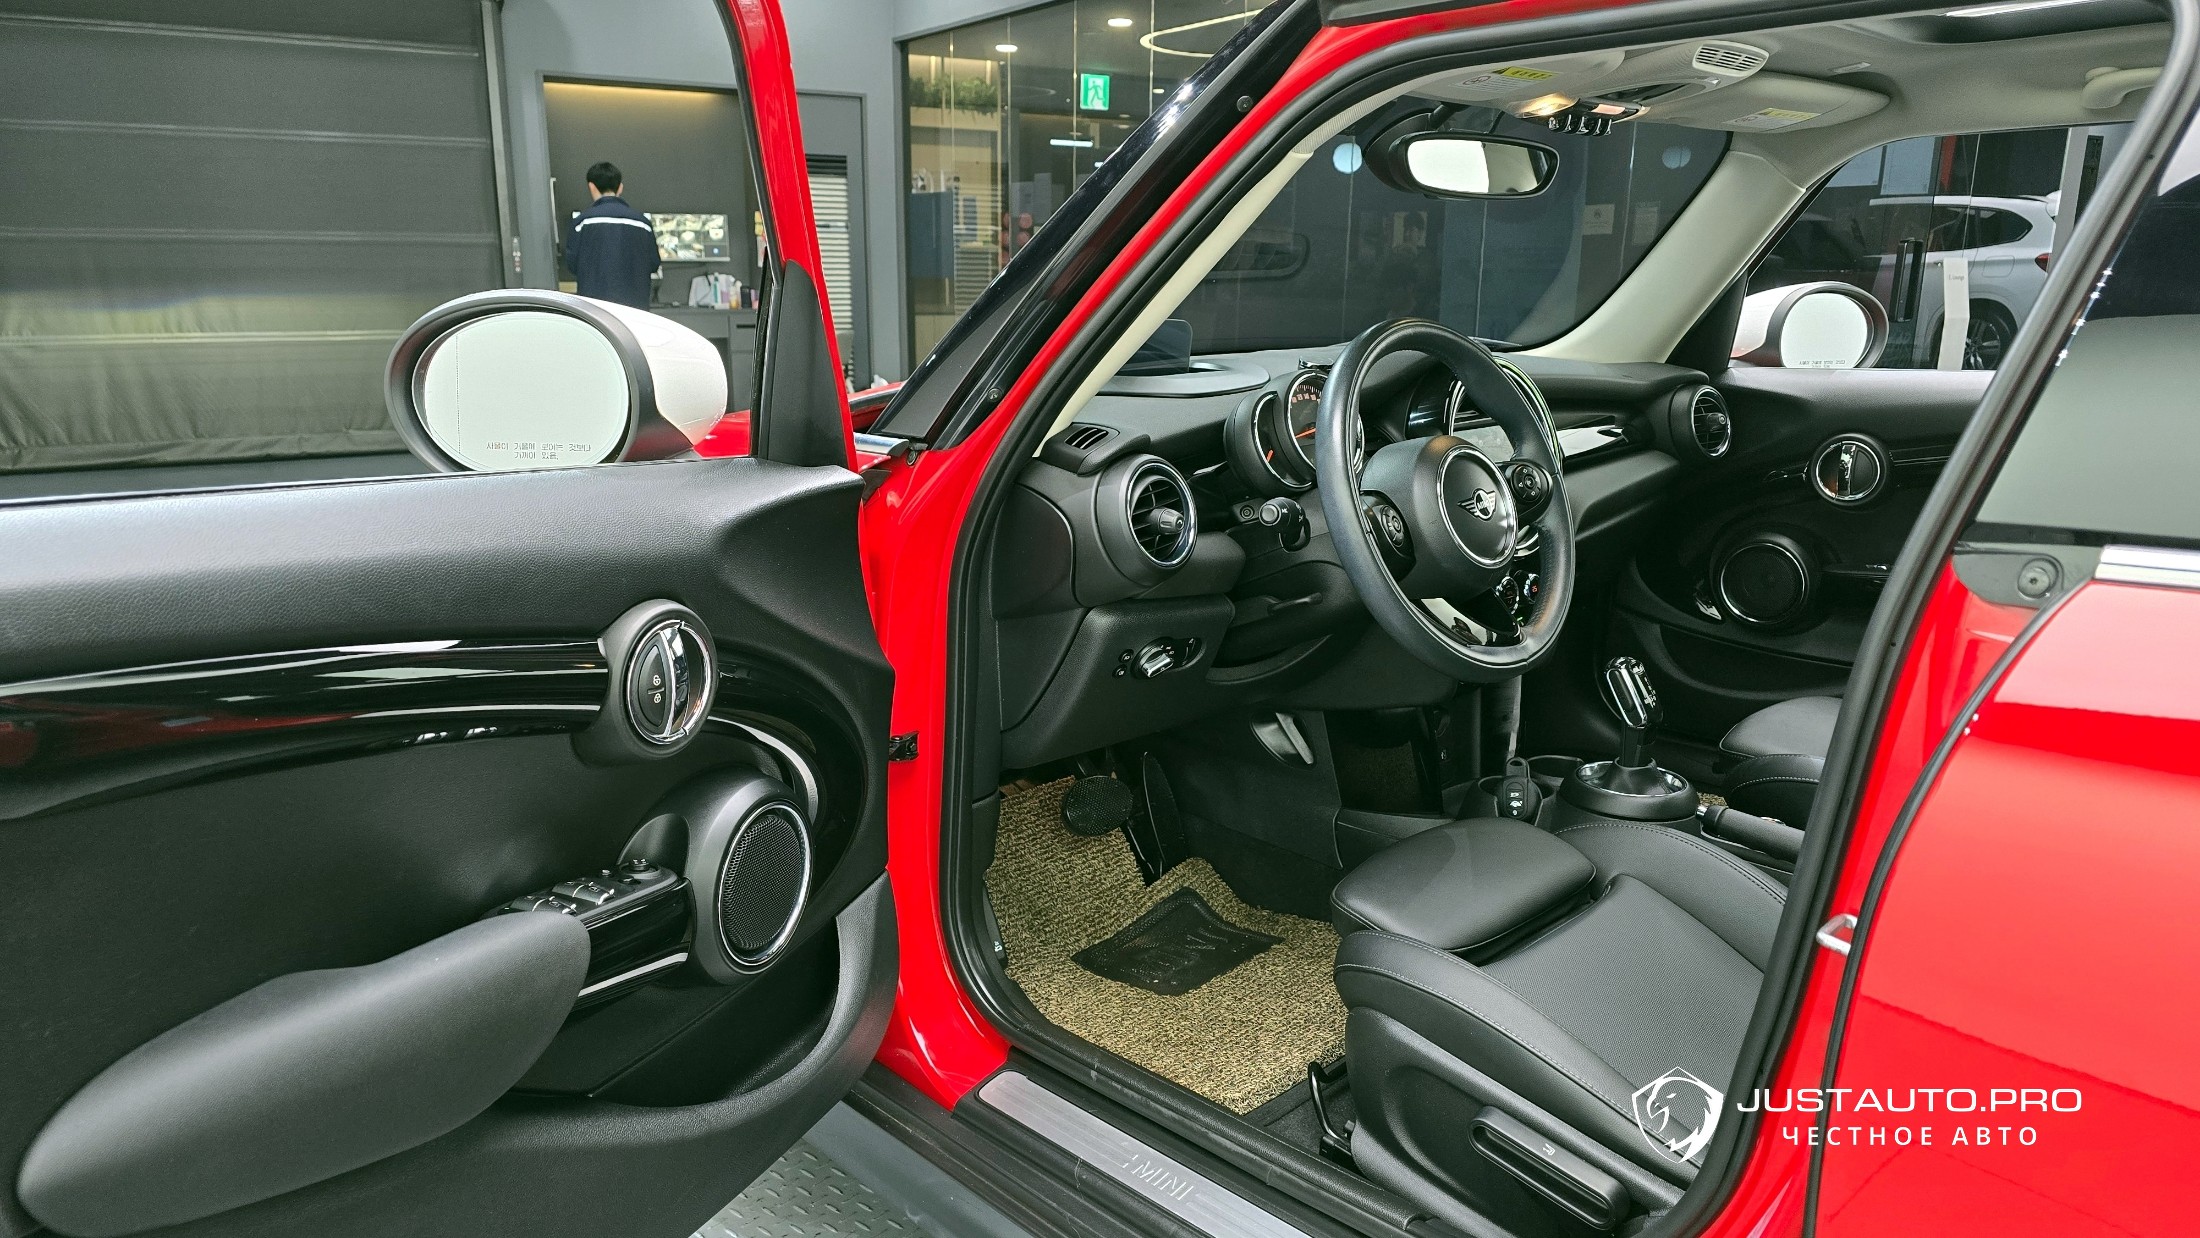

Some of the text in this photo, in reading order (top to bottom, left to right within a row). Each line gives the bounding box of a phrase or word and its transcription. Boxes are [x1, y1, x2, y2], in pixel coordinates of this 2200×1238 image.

[486, 442, 592, 452] 사물이 거울에 보이는 것보다
[514, 451, 536, 460] 가까이
[1131, 1161, 1194, 1201] MINI
